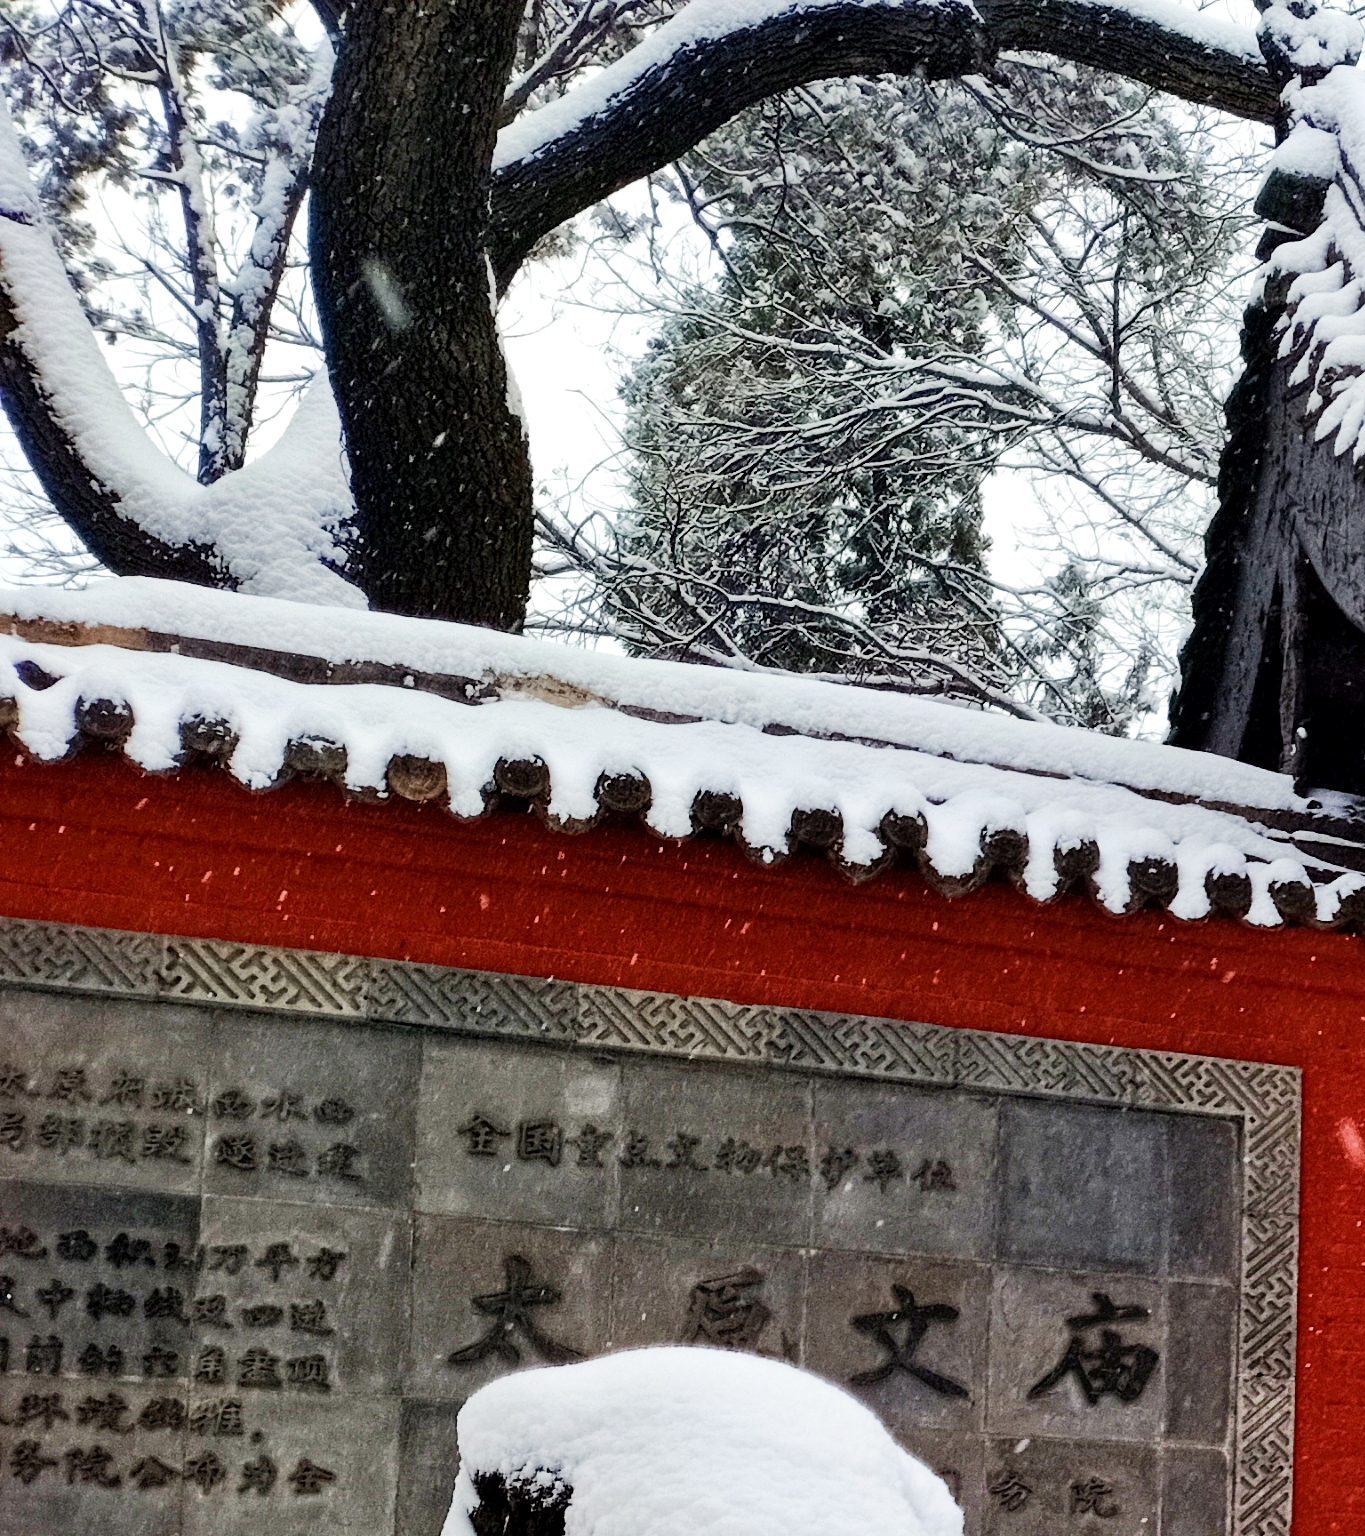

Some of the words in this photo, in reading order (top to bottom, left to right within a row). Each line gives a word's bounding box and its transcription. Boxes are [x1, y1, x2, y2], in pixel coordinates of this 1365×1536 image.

[458, 1113, 957, 1194] 全国重点文物保护单位
[448, 1253, 1162, 1406] 太原文庙
